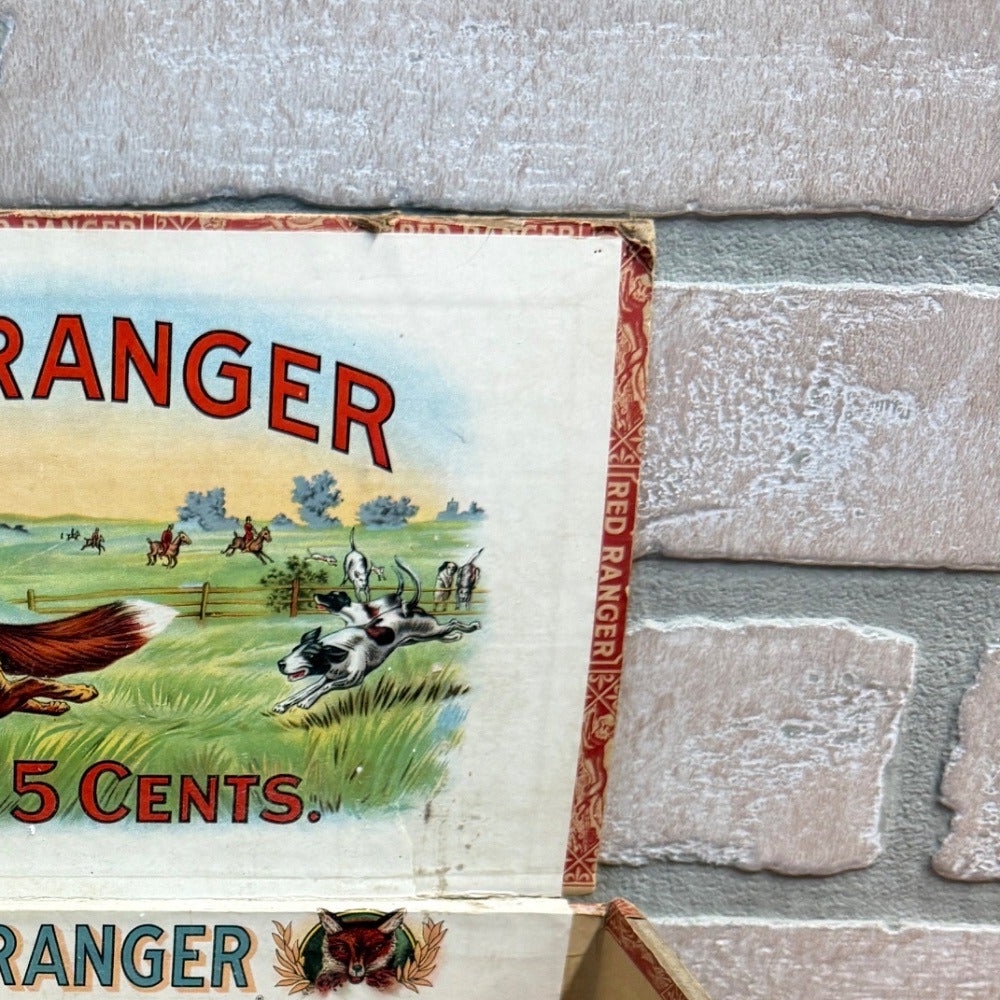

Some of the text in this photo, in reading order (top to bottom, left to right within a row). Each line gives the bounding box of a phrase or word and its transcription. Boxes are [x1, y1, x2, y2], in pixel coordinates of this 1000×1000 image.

[592, 481, 630, 657] RED RANGER
[10, 759, 58, 824] 5
